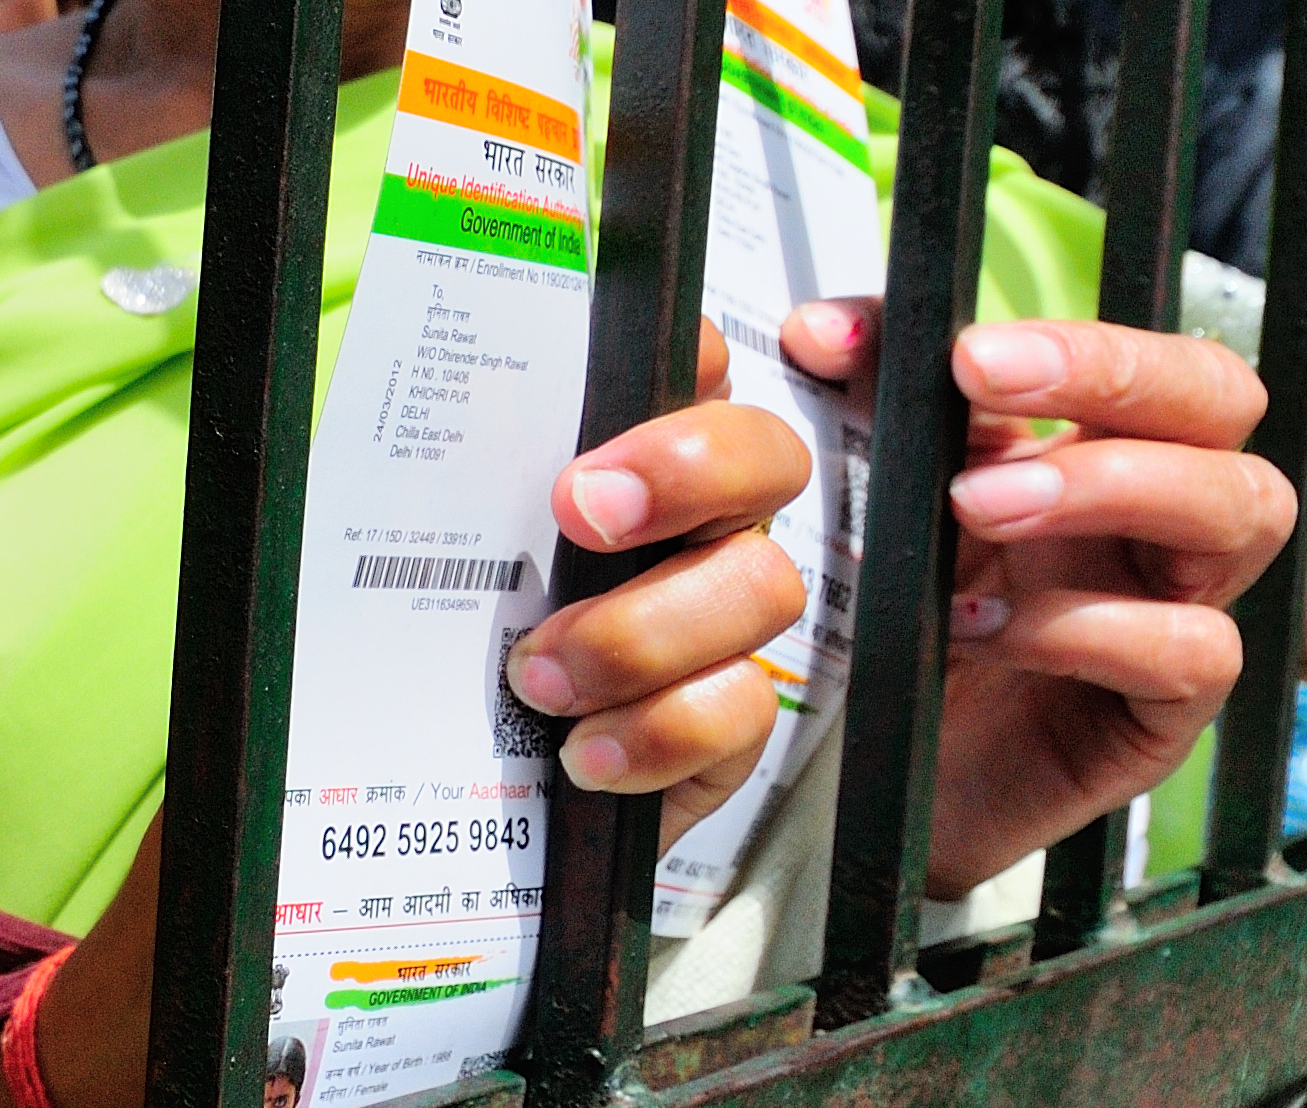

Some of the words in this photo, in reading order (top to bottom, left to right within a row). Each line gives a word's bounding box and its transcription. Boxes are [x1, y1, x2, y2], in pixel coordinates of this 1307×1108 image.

[424, 77, 478, 115] भारतीय
[484, 140, 525, 177] भारत
[535, 153, 575, 193] सरकार
[407, 162, 458, 199] Unique
[460, 175, 539, 214] Identification
[461, 207, 542, 247] Government
[545, 225, 557, 249] of
[476, 258, 525, 282] Enrollment
[527, 268, 539, 284] No
[421, 325, 449, 341] Sunita
[450, 329, 477, 344] Rawat
[411, 365, 421, 378] H
[480, 354, 503, 371] Singh
[373, 359, 403, 443] 24/03/2012
[408, 386, 449, 402] KHICHRI
[450, 390, 471, 404] PUR
[400, 405, 431, 420] DELHI
[421, 427, 442, 441] East
[442, 429, 465, 443] Delhi
[389, 444, 413, 459] Delhi
[414, 446, 446, 461] 110091
[284, 788, 311, 807] पका
[319, 787, 358, 806] आधार
[431, 782, 465, 800] Your
[469, 782, 532, 800] Aadhaar
[322, 823, 386, 861] 6492
[397, 820, 459, 856] 5925
[469, 817, 531, 852] 9843
[359, 896, 394, 919] आम
[403, 886, 451, 916] आदमी
[461, 891, 480, 911] का
[490, 882, 544, 910] अधिका
[397, 964, 427, 983] भारत
[434, 961, 472, 979] सरकार
[369, 985, 443, 1007] GOVERNMENT
[444, 983, 460, 997] OF
[333, 1040, 364, 1053] Sunita
